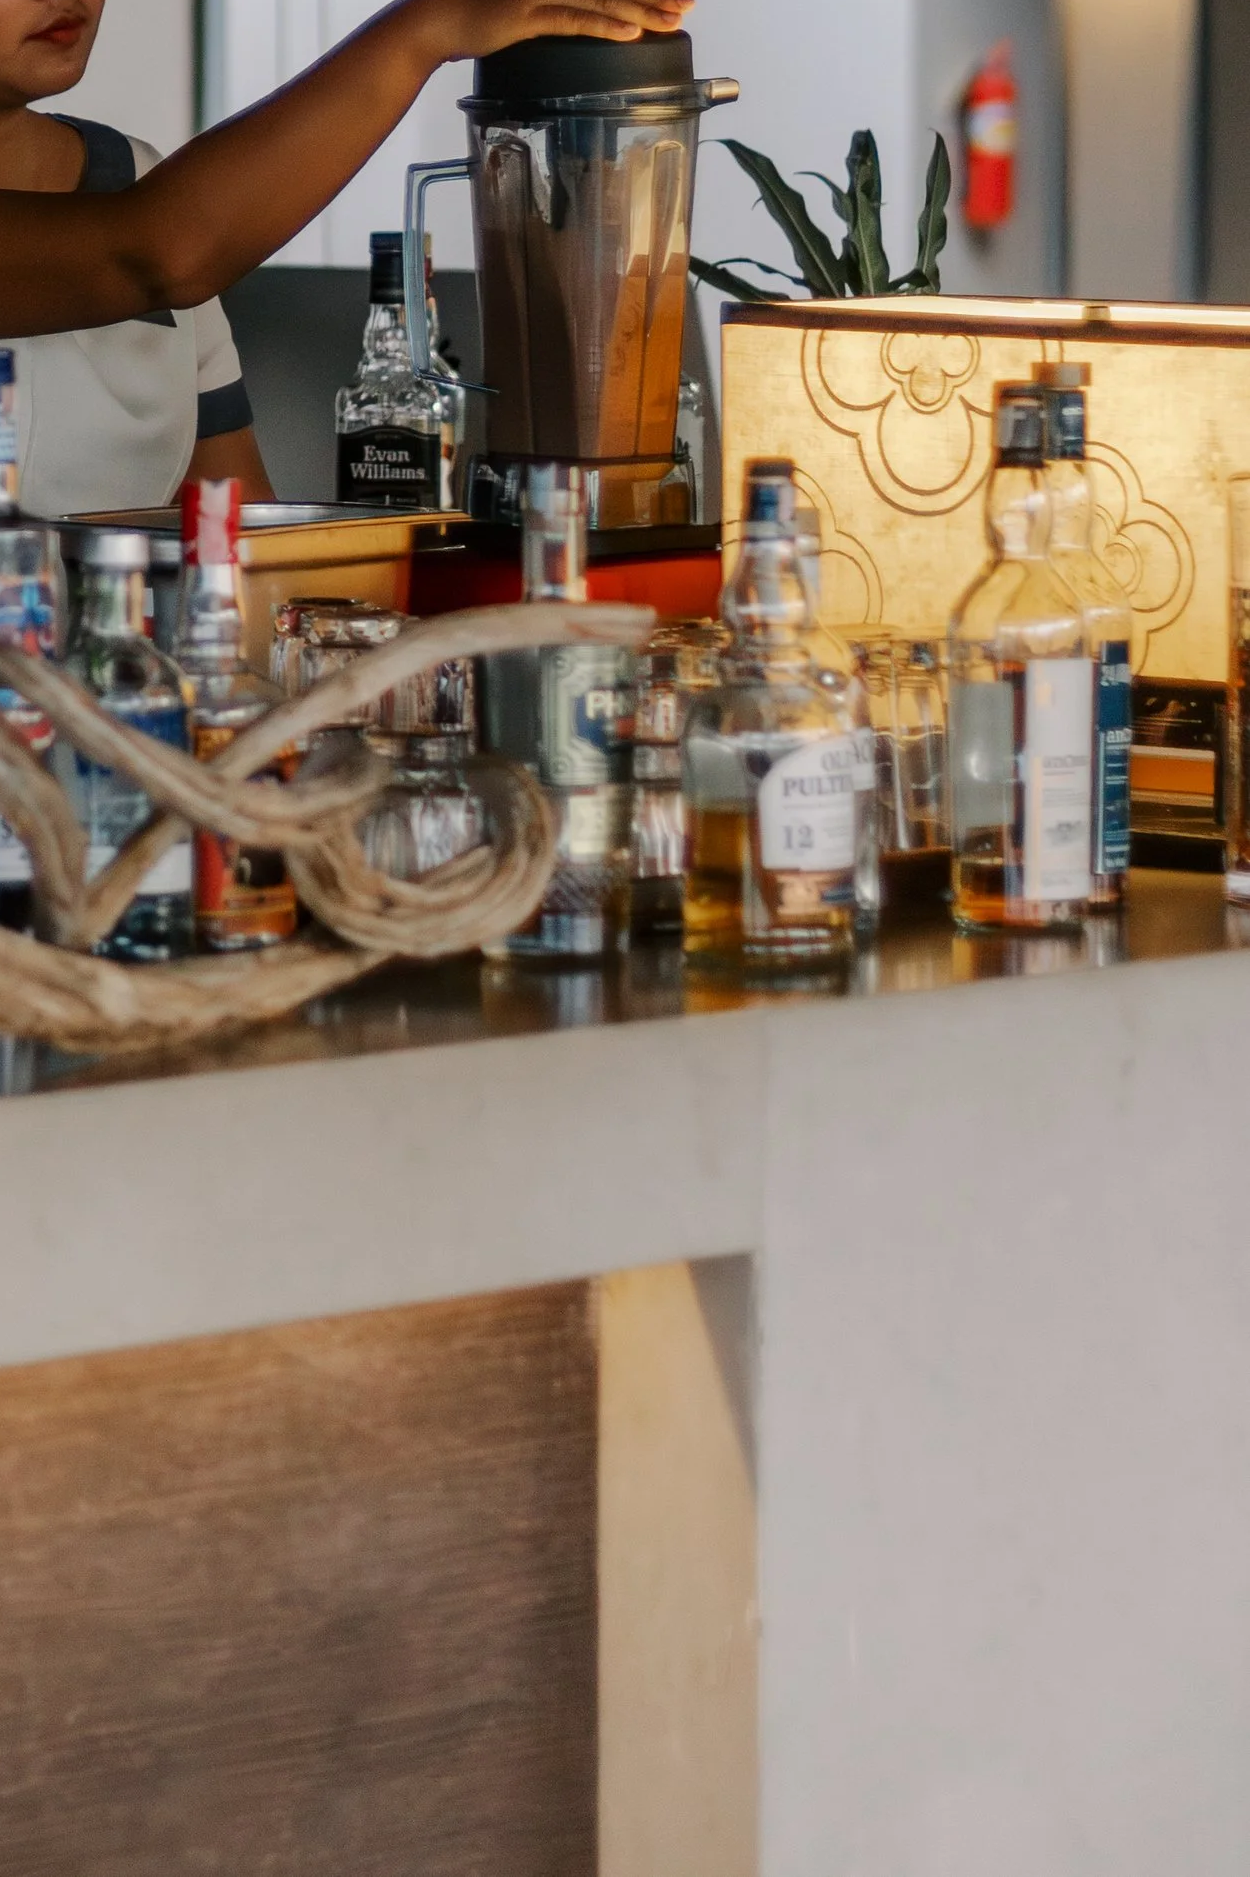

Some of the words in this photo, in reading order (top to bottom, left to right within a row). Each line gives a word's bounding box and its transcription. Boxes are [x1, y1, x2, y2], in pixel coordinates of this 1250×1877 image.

[363, 445, 410, 462] Evan
[350, 463, 426, 480] Williams
[783, 825, 814, 850] 12
